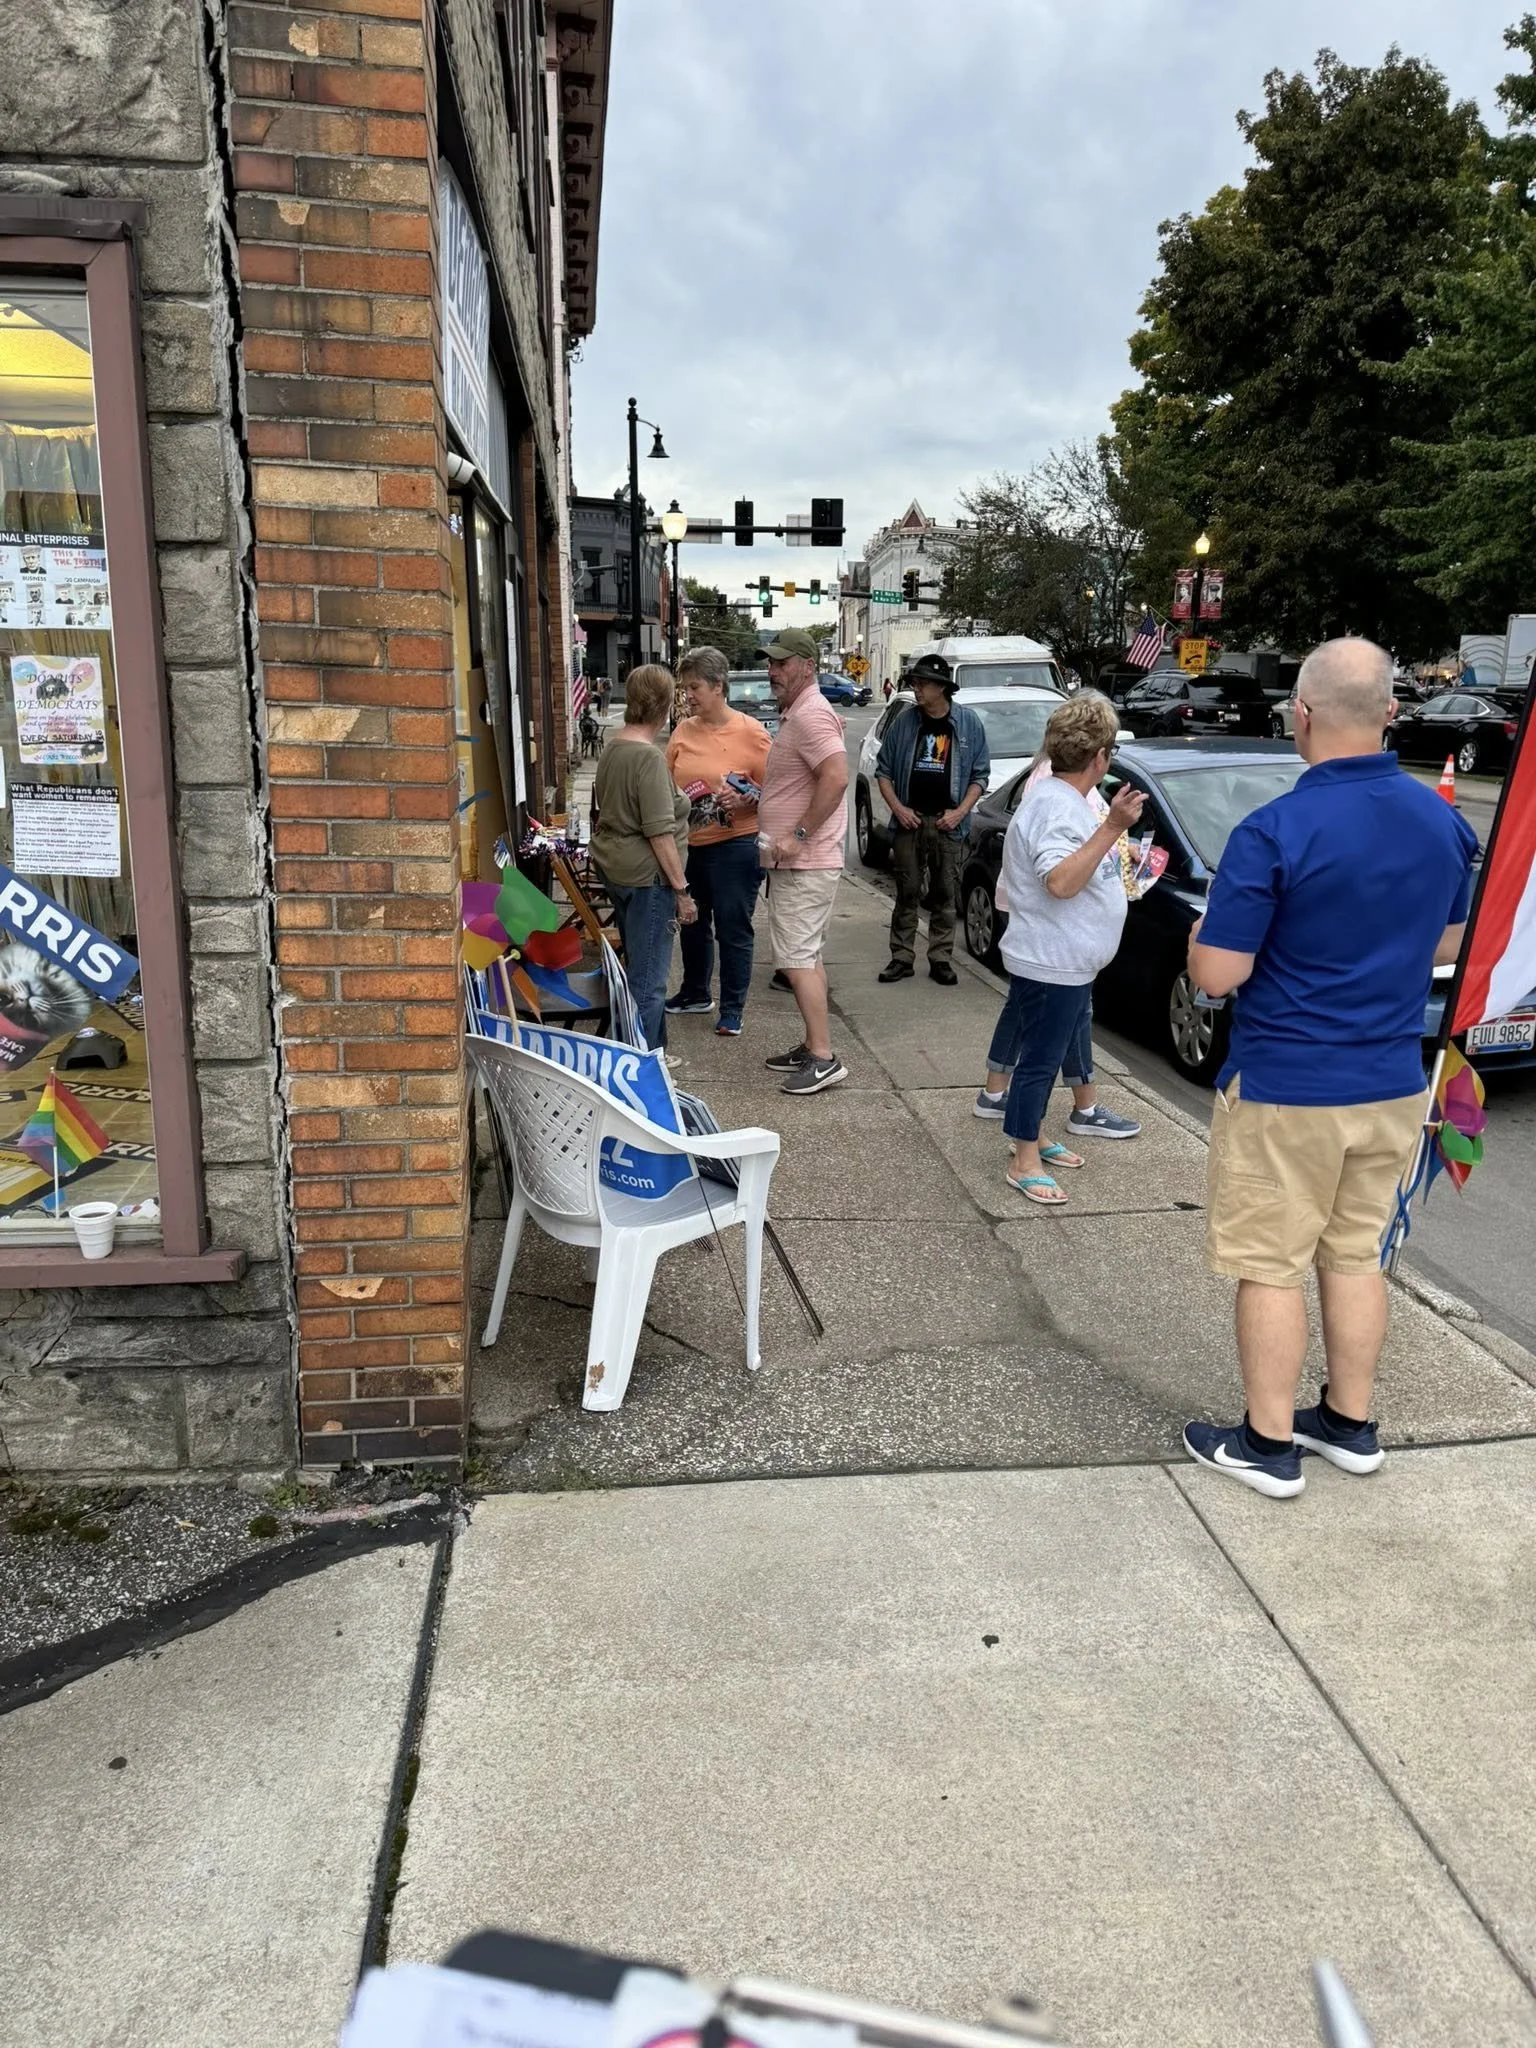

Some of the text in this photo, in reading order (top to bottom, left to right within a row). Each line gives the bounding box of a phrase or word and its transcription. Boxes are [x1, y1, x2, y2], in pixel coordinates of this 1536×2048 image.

[24, 533, 90, 546] ENTERPRISES
[51, 549, 73, 557] THIS
[1184, 641, 1205, 650] STOP
[16, 699, 98, 710] DEMOCRATS
[20, 733, 92, 742] EVERY SATURDAY
[11, 783, 119, 796] What Republicans don't
[12, 791, 32, 799] want
[66, 793, 74, 801] to
[76, 794, 118, 802] remember
[0, 879, 122, 983] RRIS
[1472, 1023, 1531, 1046] EUU 9852
